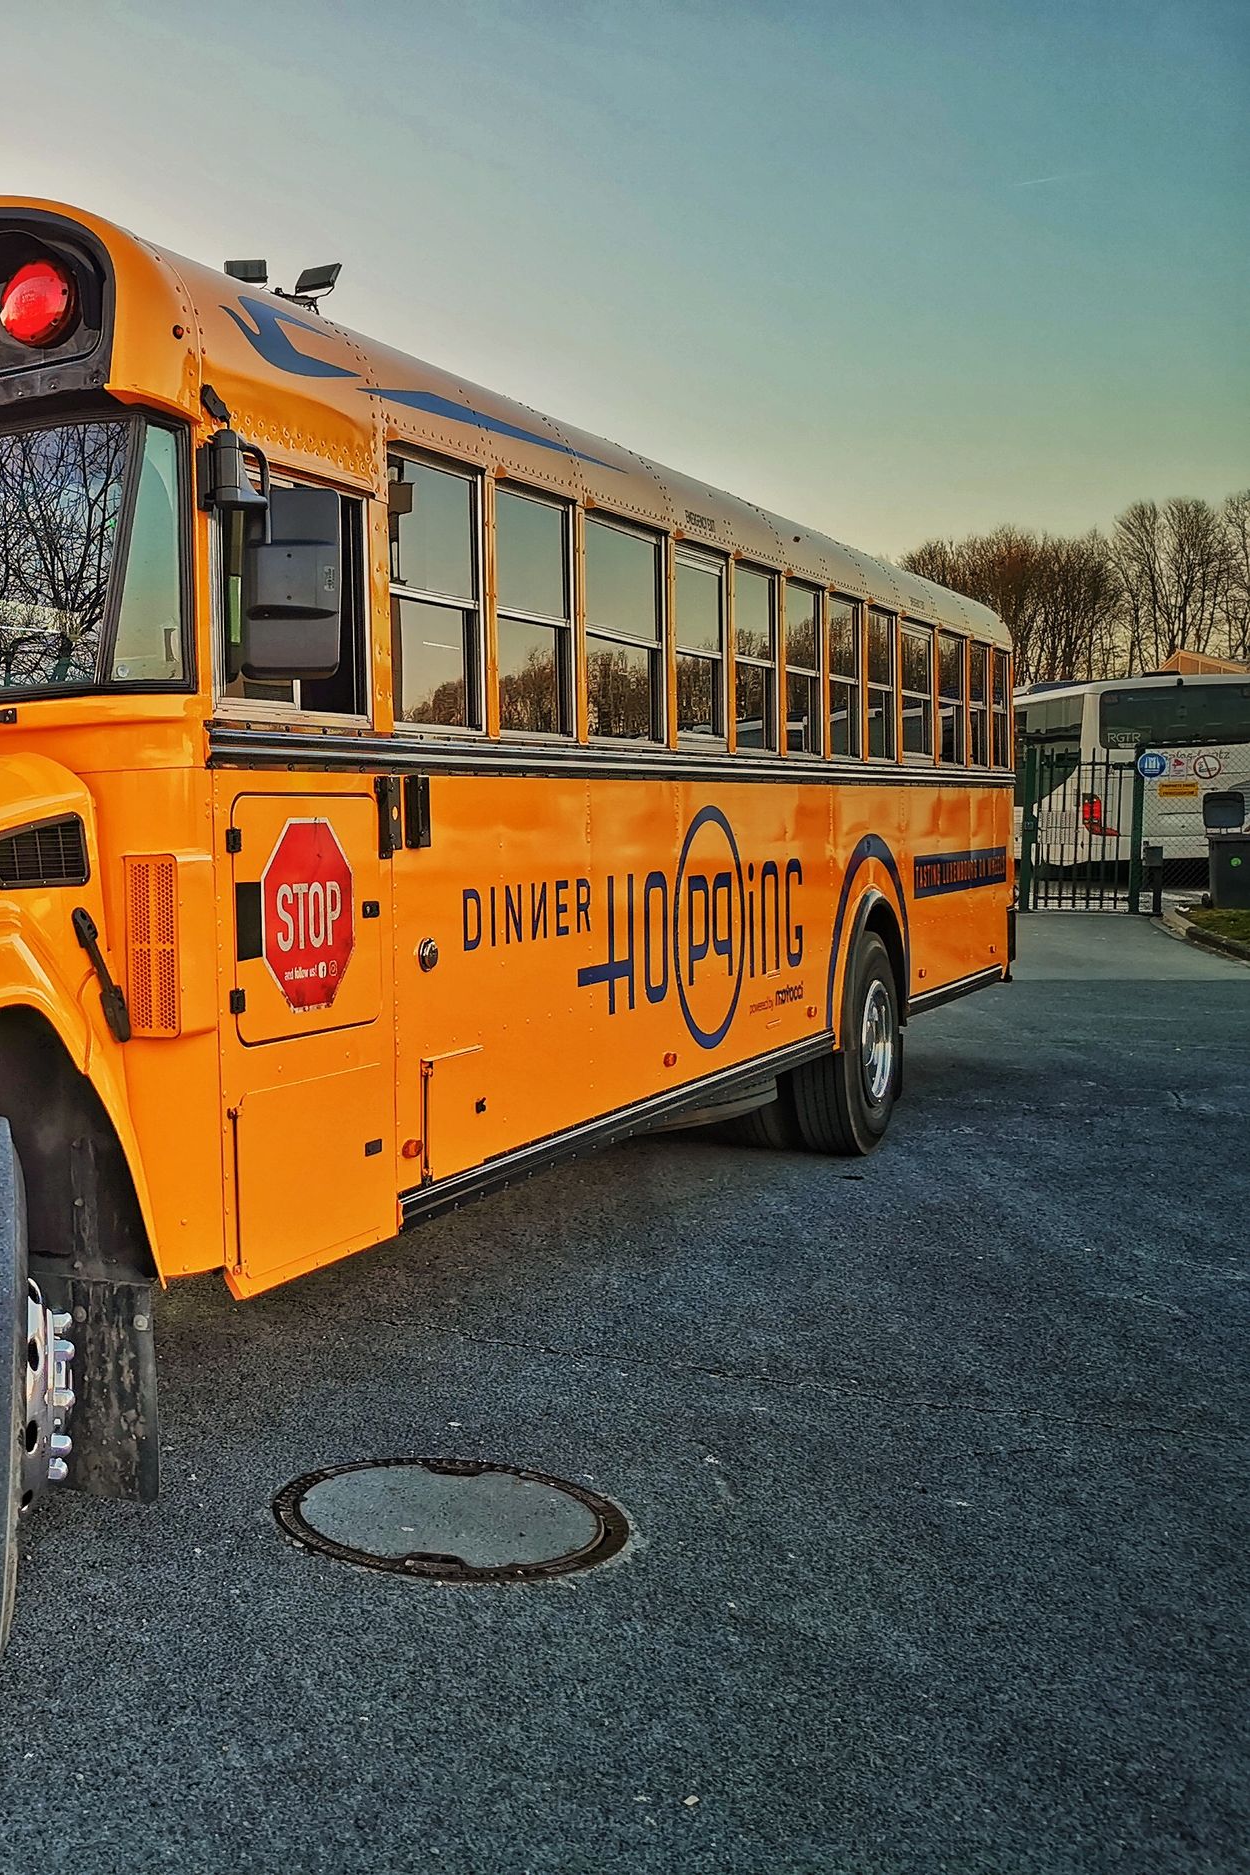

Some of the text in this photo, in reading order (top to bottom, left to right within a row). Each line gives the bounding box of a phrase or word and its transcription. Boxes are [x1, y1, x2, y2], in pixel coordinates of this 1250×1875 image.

[1107, 732, 1141, 743] RGTR
[276, 881, 342, 952] STOP
[463, 878, 591, 952] DINNER
[284, 968, 293, 981] and
[294, 965, 308, 979] follow
[309, 964, 317, 977] us!
